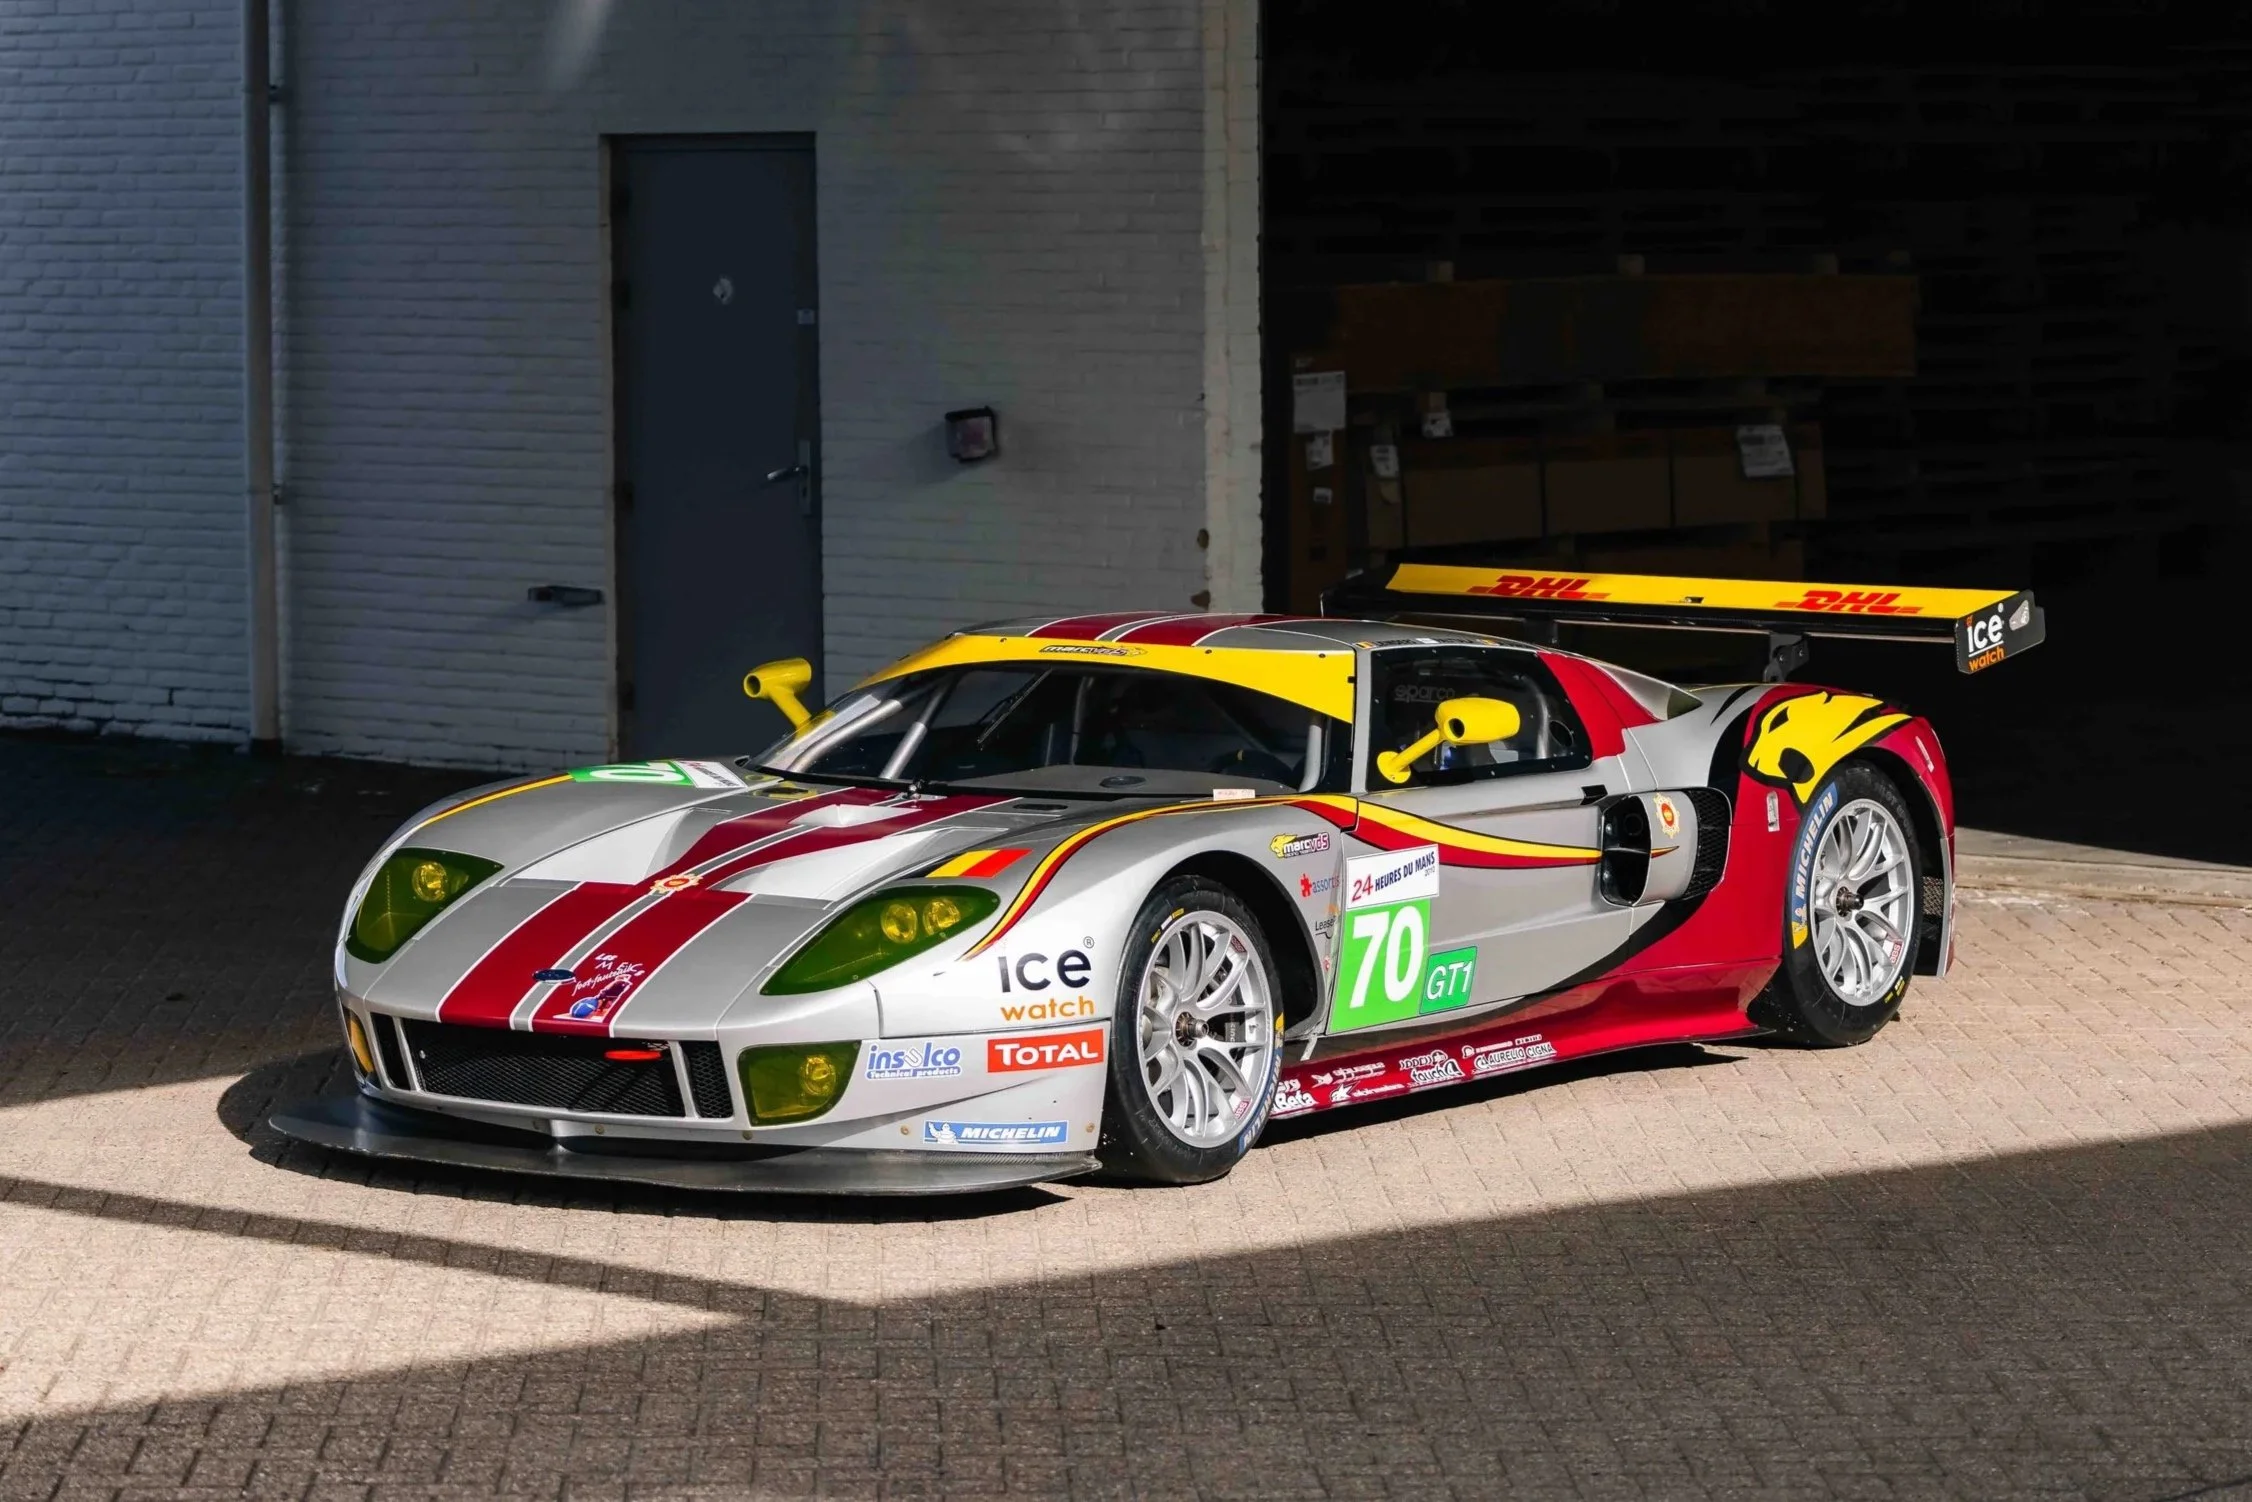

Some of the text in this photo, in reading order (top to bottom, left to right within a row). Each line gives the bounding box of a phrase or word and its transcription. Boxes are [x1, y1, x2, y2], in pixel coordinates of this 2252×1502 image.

[1487, 575, 1590, 599] DHL
[1795, 590, 1901, 614] DHL
[1966, 614, 2003, 653] ice
[1968, 646, 2005, 671] watch
[1794, 791, 1834, 900] MICHELIN
[1352, 851, 1436, 902] 24 HEURES DU MANS
[1350, 905, 1424, 1008] 70
[998, 949, 1092, 993] ice
[1427, 961, 1473, 1000] GT1
[1001, 996, 1095, 1022] watch
[994, 1041, 1099, 1066] TOTAL
[1526, 1042, 1554, 1058] CIGNA
[869, 1067, 960, 1080] Technical products
[961, 1126, 1062, 1140] MICHELIN
